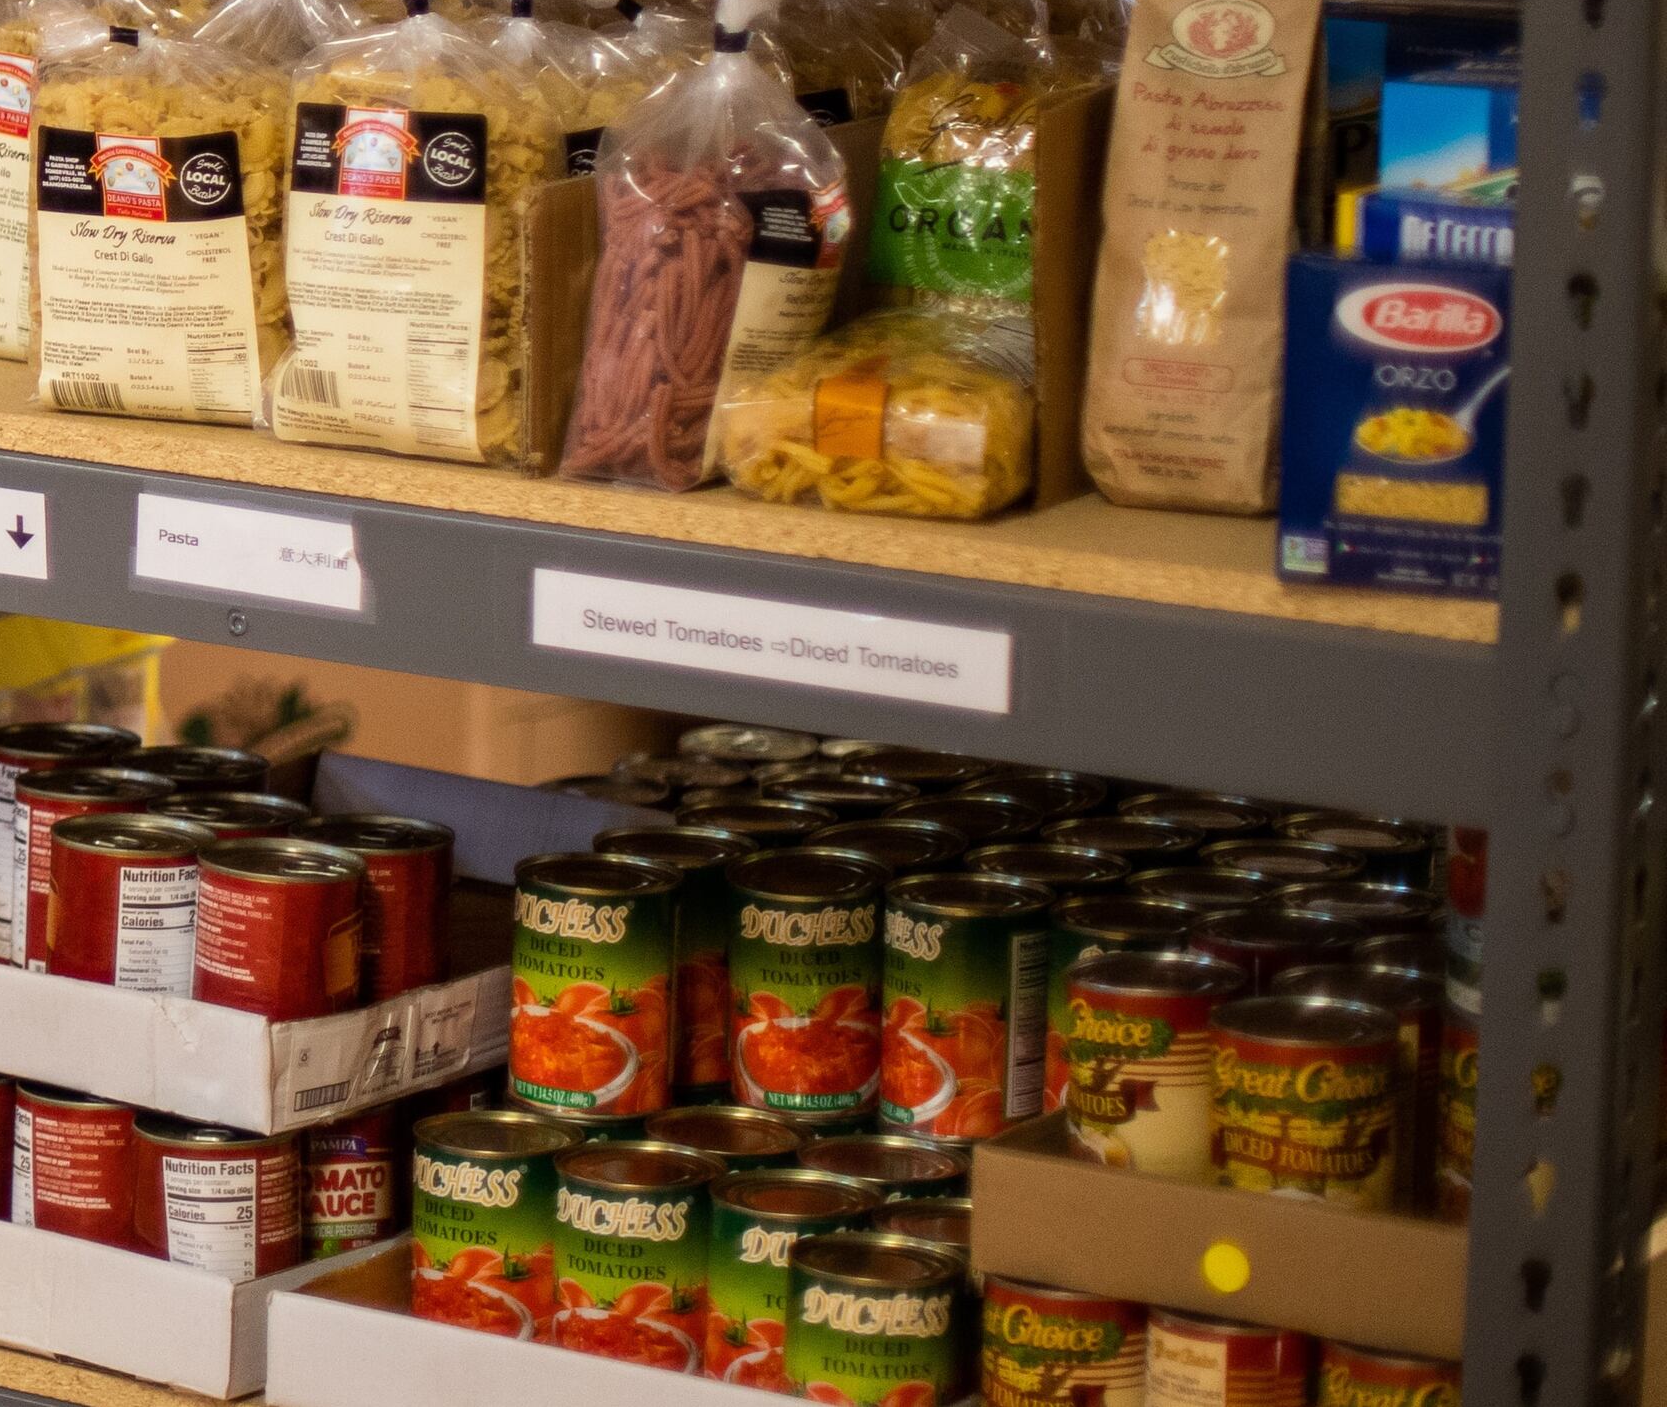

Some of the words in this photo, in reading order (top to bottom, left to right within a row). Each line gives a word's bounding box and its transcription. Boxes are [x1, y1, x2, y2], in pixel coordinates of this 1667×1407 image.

[1134, 82, 1182, 105] Pasta
[430, 148, 471, 169] LOCAL
[186, 171, 226, 186] LOCAL
[375, 174, 401, 185] PASTA
[107, 194, 137, 205] DEANO'S
[138, 197, 161, 207] PASTA
[334, 205, 358, 229] Dry
[364, 207, 413, 226] Riserva
[70, 220, 99, 239] Slow
[103, 225, 128, 248] Dry
[133, 228, 176, 245] Riserva
[325, 230, 346, 243] Crest
[349, 232, 358, 243] Di
[360, 233, 385, 246] Gallo
[94, 249, 118, 261] Crest
[120, 251, 130, 261] Di
[132, 252, 154, 264] Gallo
[1374, 299, 1487, 335] Barilla
[187, 332, 221, 340] Nutrition
[1375, 364, 1458, 392] ORZO
[354, 412, 396, 426] FRAGILE
[158, 529, 199, 548] Pasta
[583, 609, 656, 638] Stewed
[664, 620, 762, 652] Tomatoes
[790, 637, 850, 665] Diced
[858, 647, 959, 679] Tomatoes
[122, 869, 175, 884] Nutrition
[121, 916, 165, 928] Calories
[741, 903, 875, 946] DUCHESS
[530, 936, 583, 958] DICED
[780, 949, 842, 966] DICED
[518, 953, 606, 982] TOMATOES
[761, 967, 863, 985] TOMATOES
[20, 1155, 31, 1172] 25
[165, 1160, 217, 1176] Nutrition
[219, 1161, 255, 1177] Facts
[168, 1206, 207, 1222] Calories
[236, 1205, 254, 1221] 25
[424, 1199, 475, 1222] DICED
[557, 1188, 689, 1242] DUCHESS
[583, 1237, 644, 1260] DICED
[567, 1254, 667, 1281] TOMATOES
[803, 1288, 950, 1337] DUCHESS
[844, 1336, 912, 1359] DICED
[821, 1356, 932, 1380] TOMATOES
